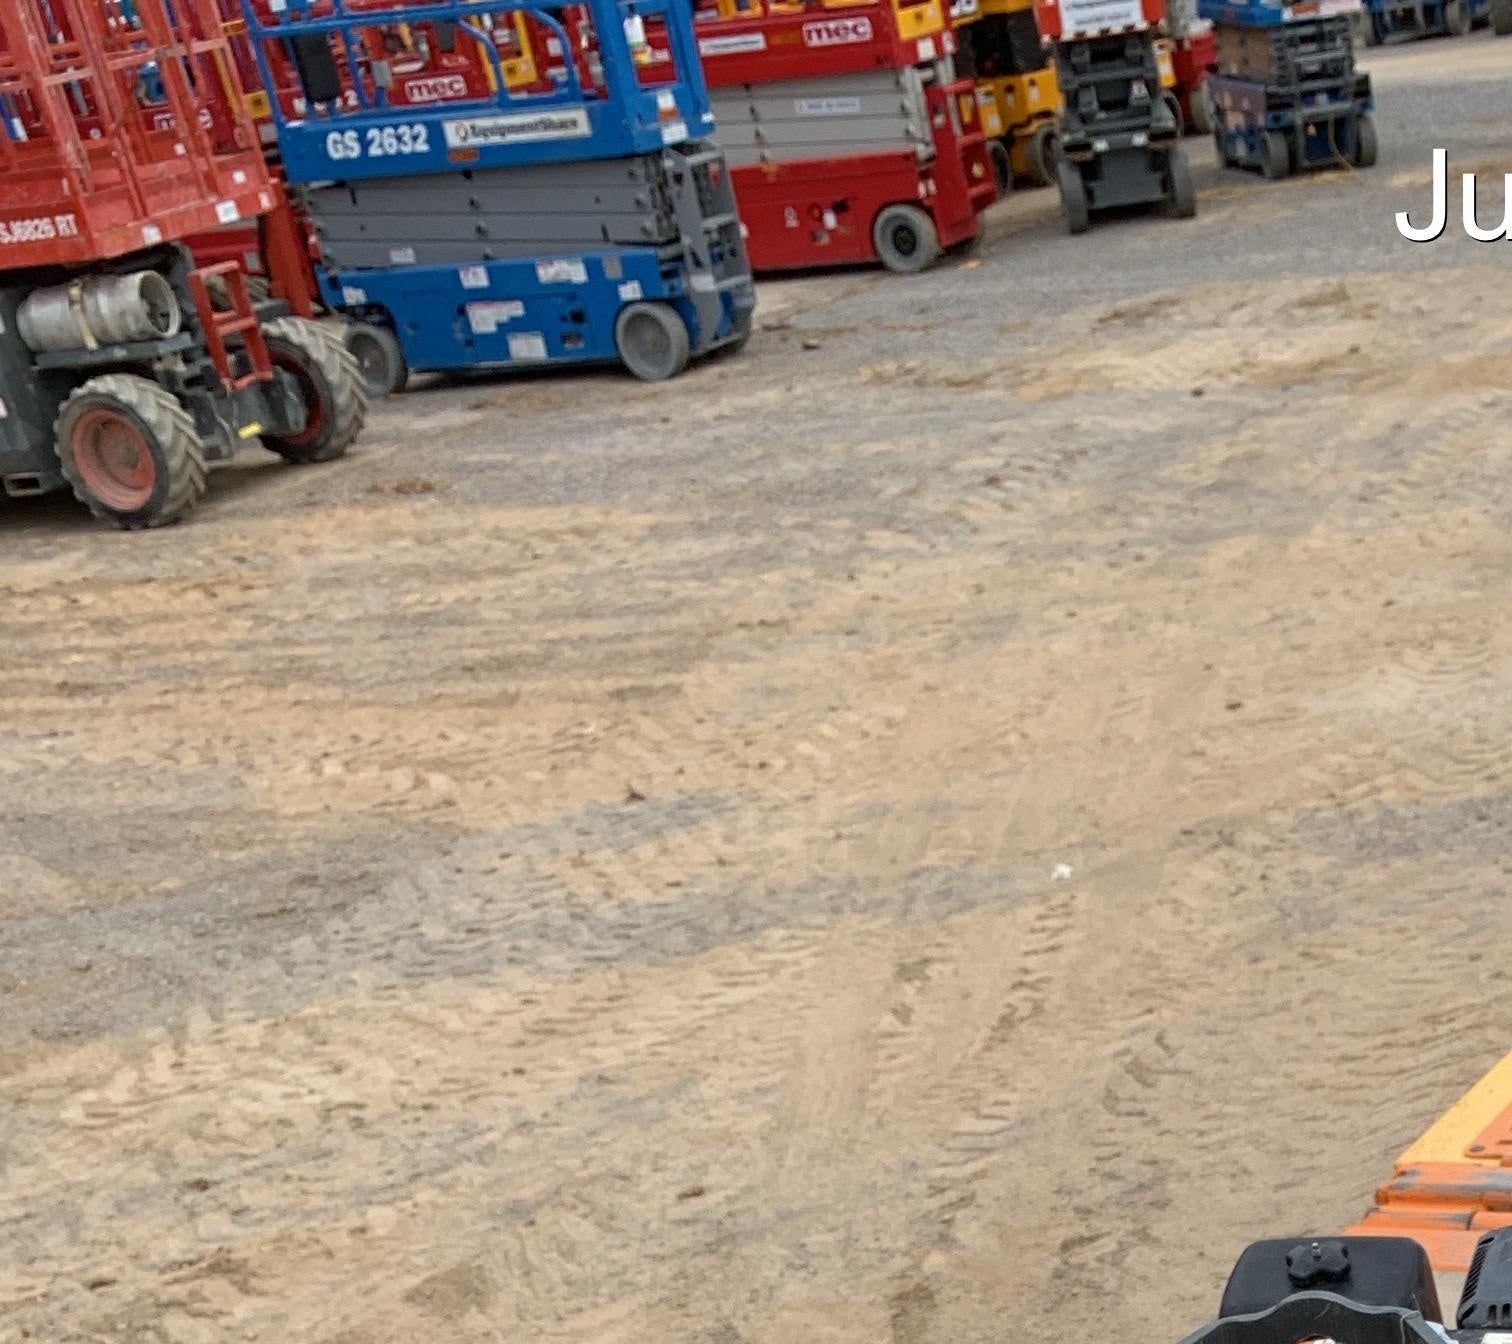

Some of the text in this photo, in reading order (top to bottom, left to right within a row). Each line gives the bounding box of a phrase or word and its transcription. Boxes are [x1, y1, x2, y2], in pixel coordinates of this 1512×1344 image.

[806, 20, 869, 41] mec
[326, 123, 430, 159] GS 2632
